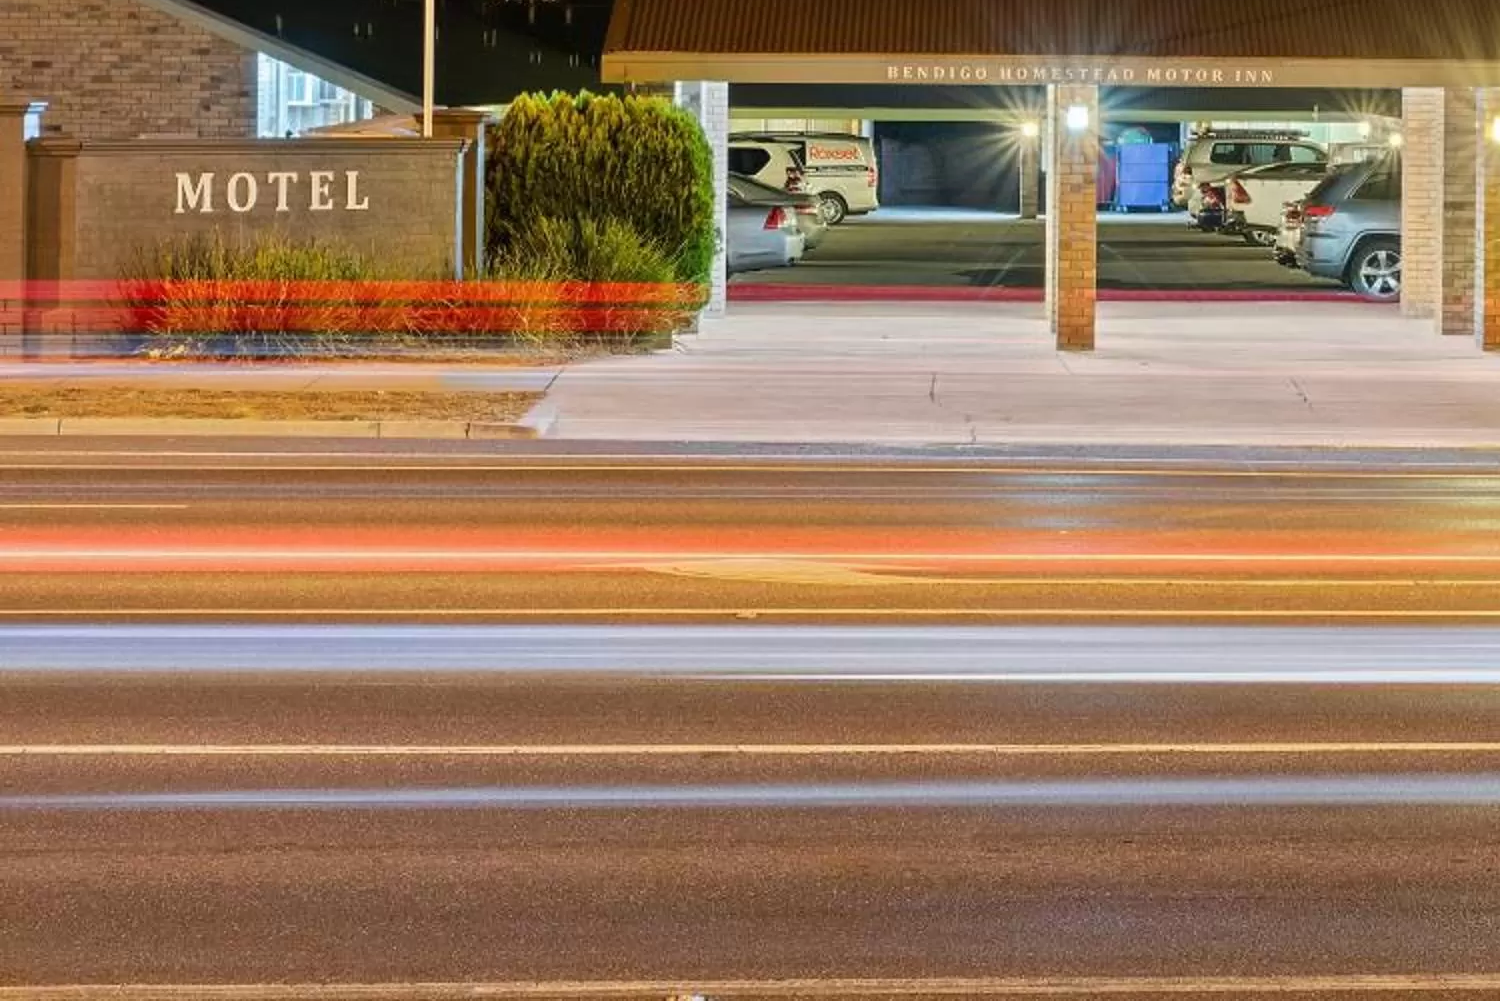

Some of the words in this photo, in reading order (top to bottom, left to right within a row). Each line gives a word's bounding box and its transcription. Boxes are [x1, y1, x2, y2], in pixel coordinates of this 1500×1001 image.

[887, 66, 988, 80] BENDIGO
[1000, 66, 1134, 81] HOMESTEAD
[1147, 68, 1224, 82] MOTOR
[1235, 69, 1274, 83] INN
[174, 171, 369, 214] MOTEL
